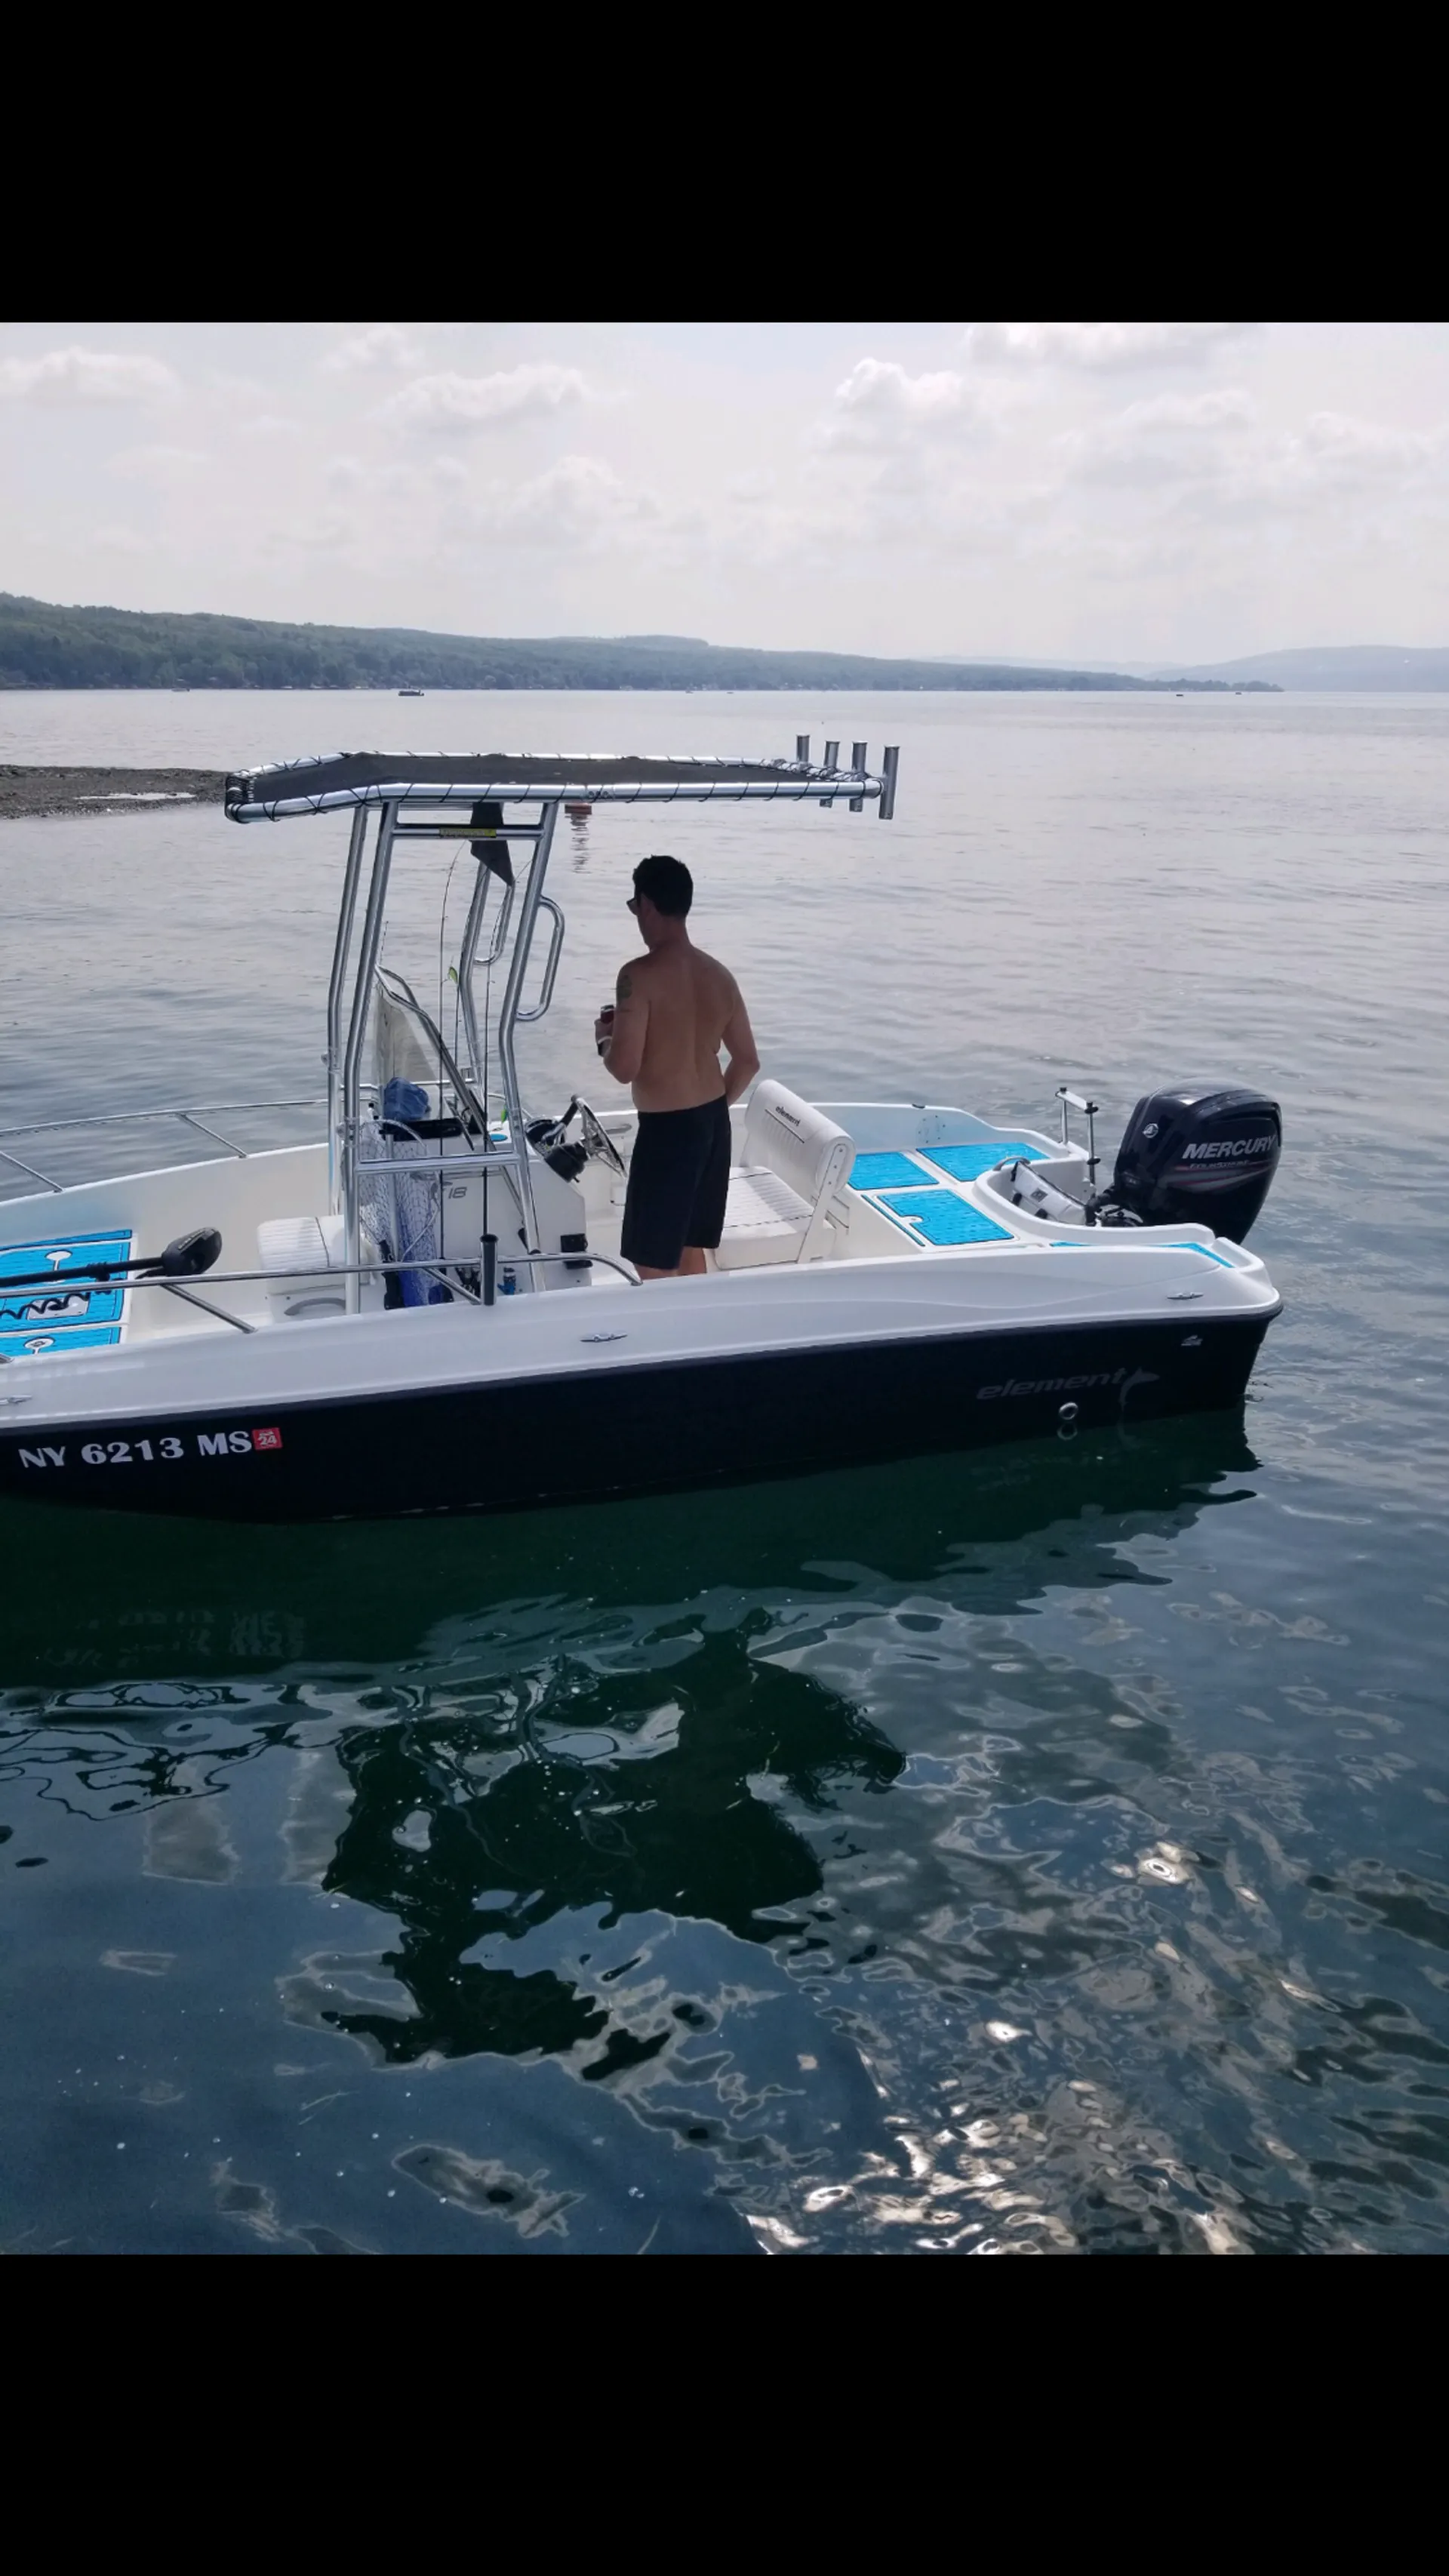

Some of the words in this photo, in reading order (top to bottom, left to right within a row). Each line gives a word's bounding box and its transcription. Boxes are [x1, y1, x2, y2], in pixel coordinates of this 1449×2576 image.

[1182, 1134, 1276, 1159] MERCURY
[977, 1368, 1127, 1399] element
[18, 1445, 66, 1468] NY
[81, 1437, 184, 1464] 6213
[197, 1430, 253, 1457] MS
